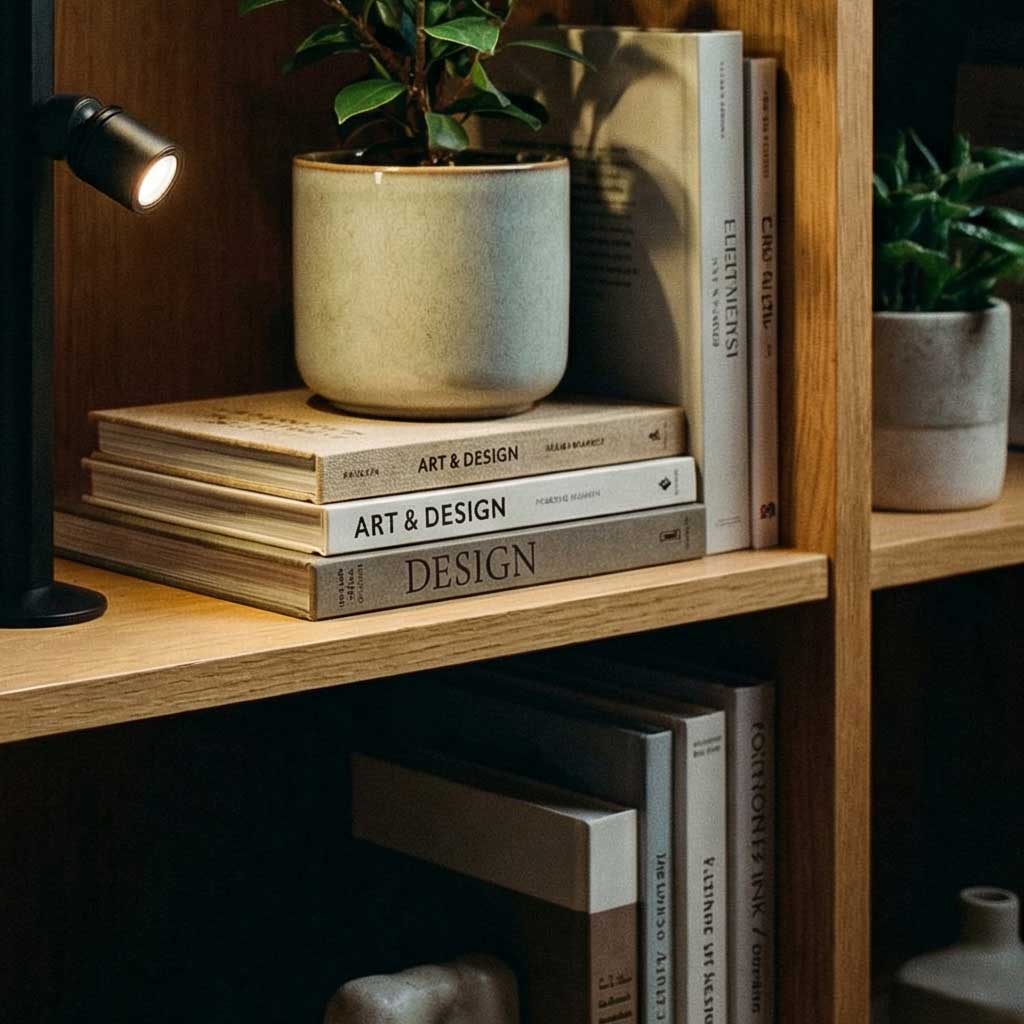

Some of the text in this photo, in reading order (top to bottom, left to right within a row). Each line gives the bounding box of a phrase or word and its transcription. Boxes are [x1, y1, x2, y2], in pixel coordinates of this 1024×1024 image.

[418, 445, 519, 473] ART & DESIGN
[354, 511, 398, 539] ART
[404, 509, 418, 531] &
[425, 496, 506, 528] DESIGN
[405, 540, 537, 594] DESIGN
